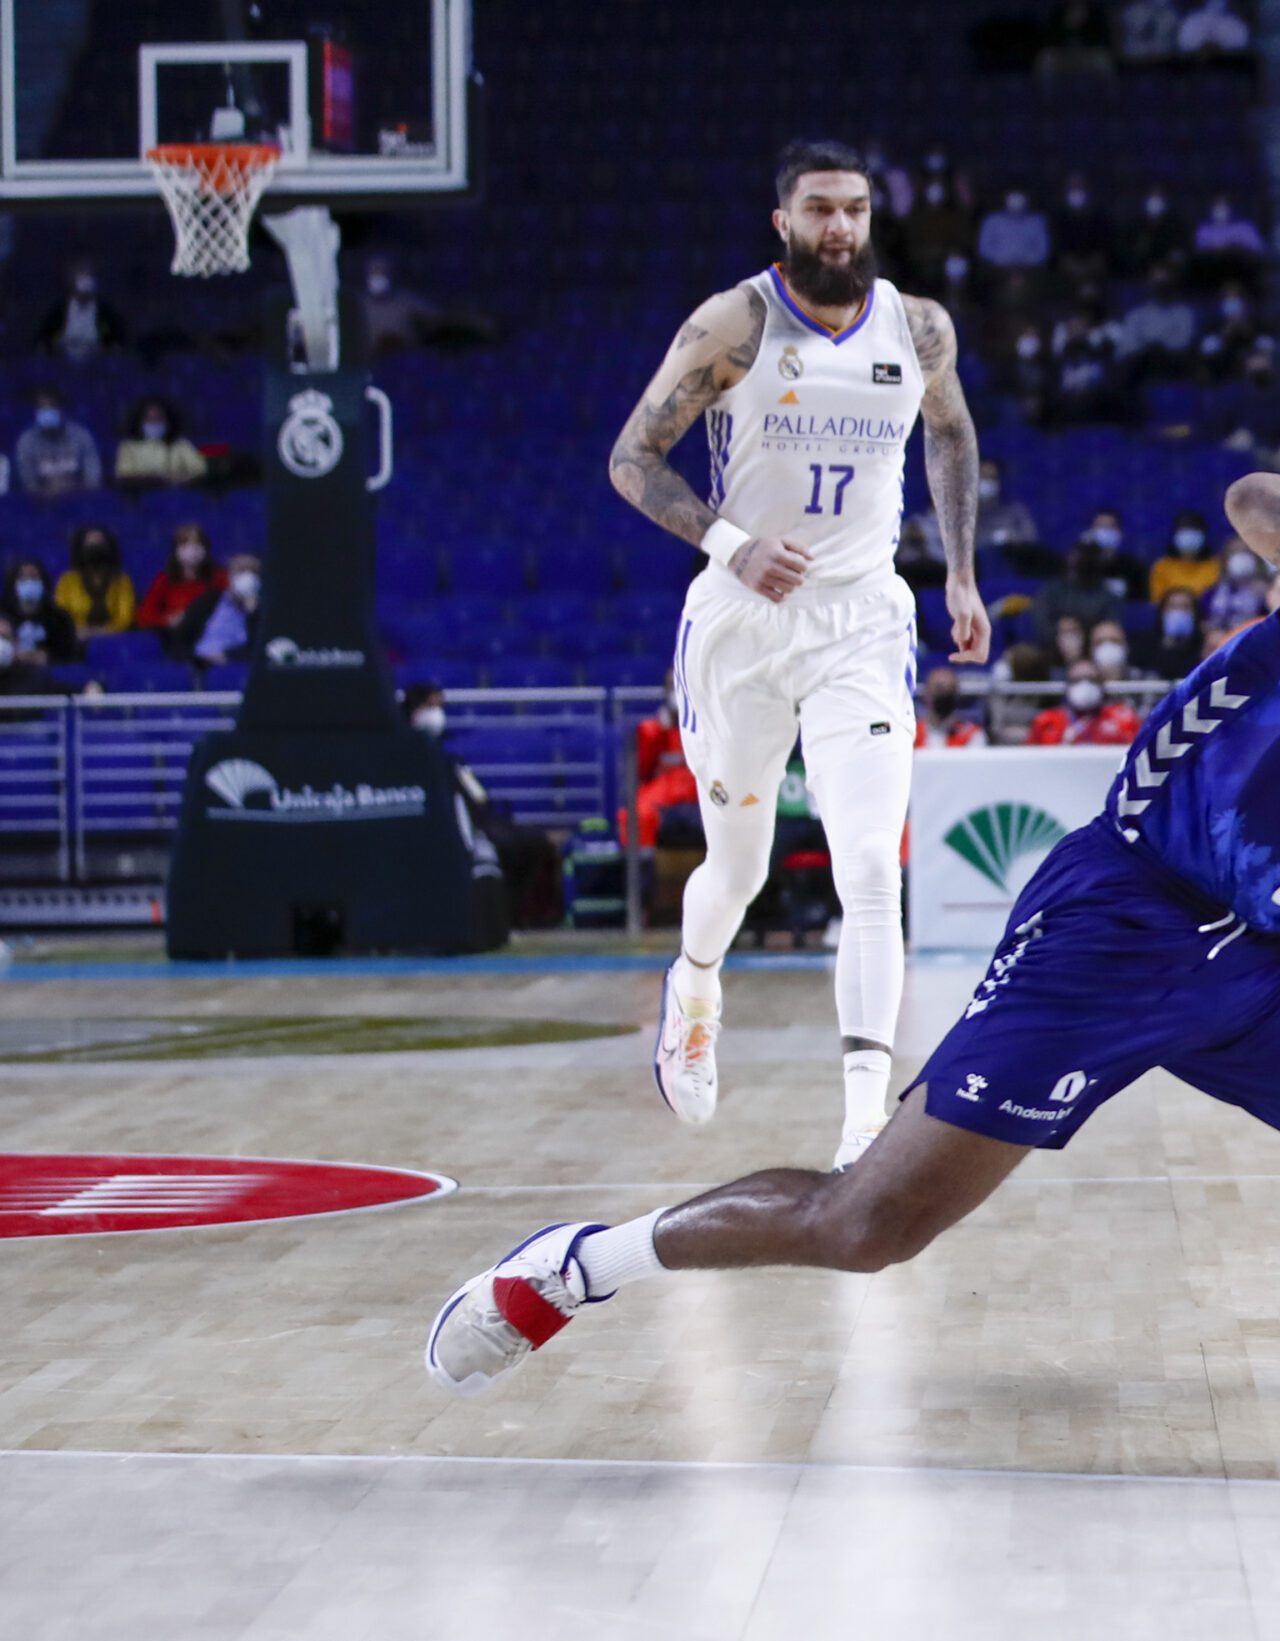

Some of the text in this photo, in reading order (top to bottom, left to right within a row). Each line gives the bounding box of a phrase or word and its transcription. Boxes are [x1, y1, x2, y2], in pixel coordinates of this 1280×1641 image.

[763, 413, 905, 440] PALLADIUM
[761, 440, 823, 452] HOTEL
[804, 463, 855, 516] 17
[998, 1098, 1057, 1121] Andorra
